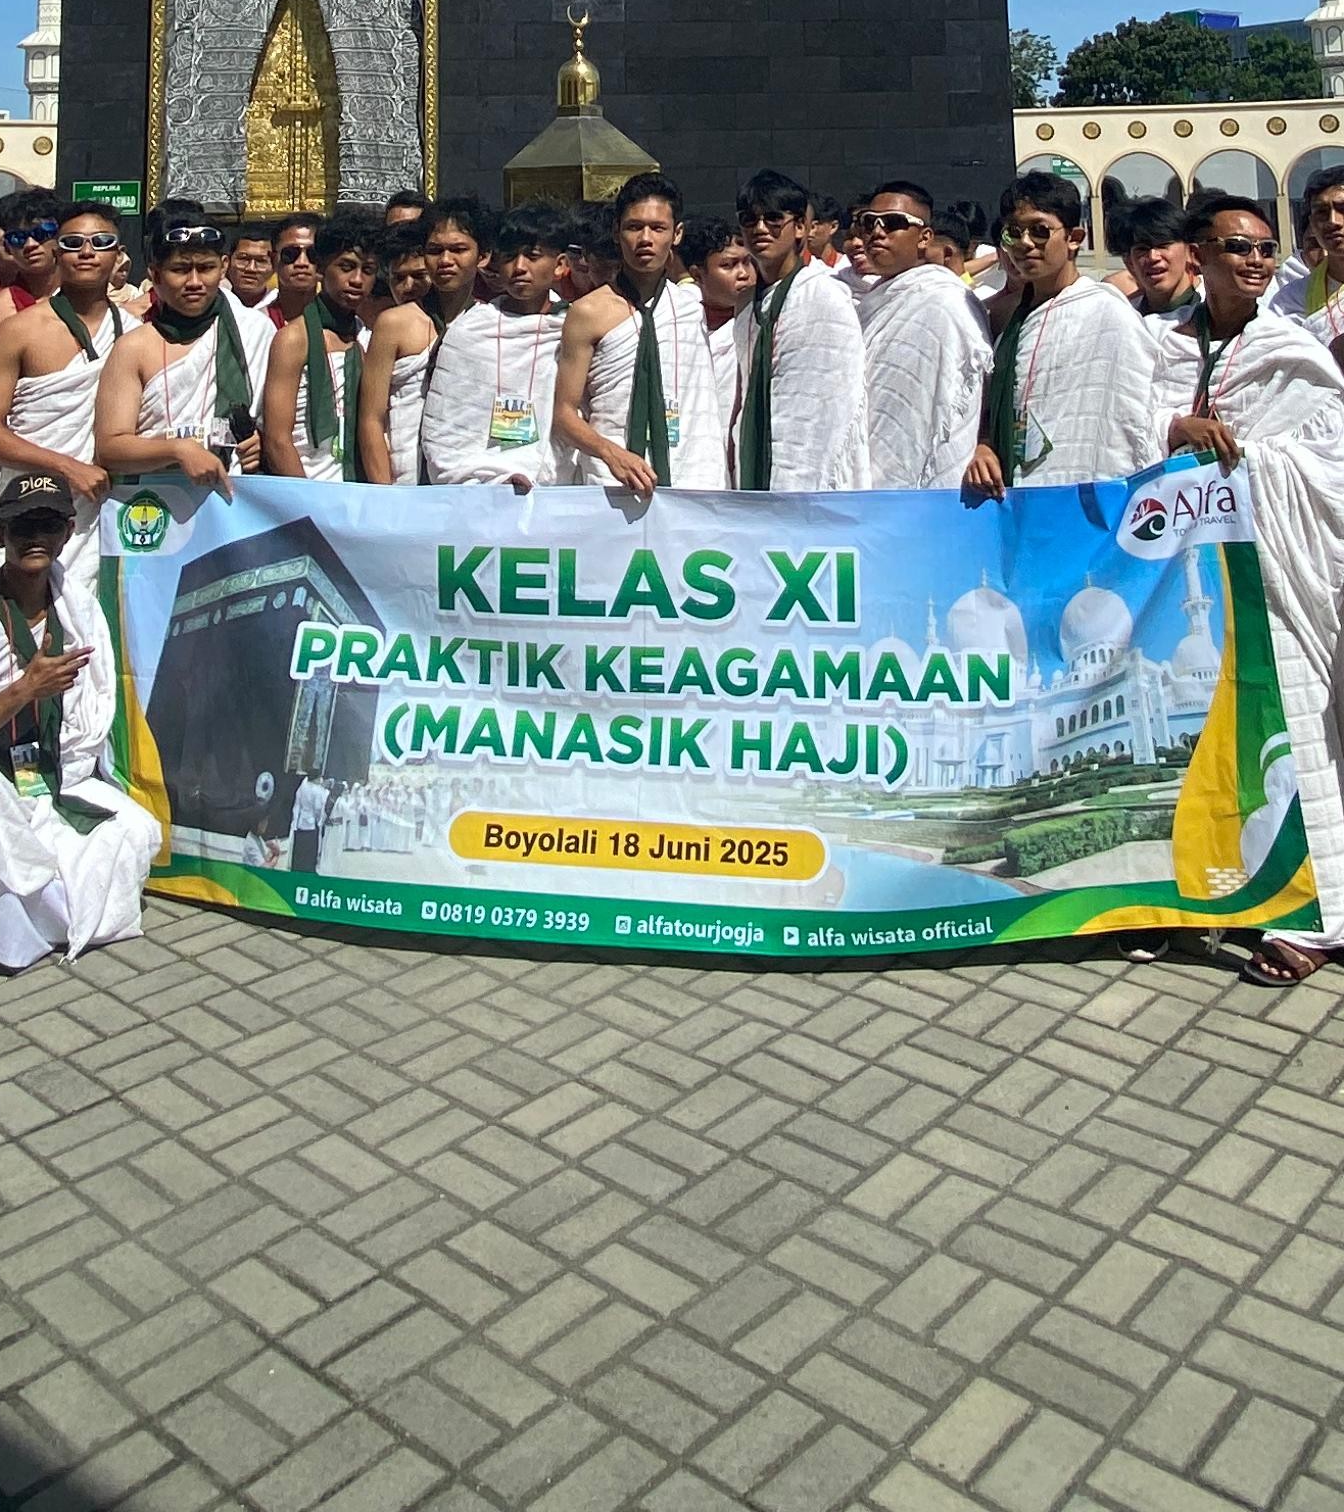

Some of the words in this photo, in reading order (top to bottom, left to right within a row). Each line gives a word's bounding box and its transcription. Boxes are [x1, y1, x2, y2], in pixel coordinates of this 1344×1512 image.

[112, 196, 136, 208] ASWAD
[19, 476, 58, 494] DIOR
[1199, 515, 1236, 527] TRAVEL
[436, 544, 735, 620] KELAS
[766, 550, 856, 623] XI
[295, 627, 568, 692] PRAKTIK
[585, 644, 1011, 702] KEAGAMAAN
[383, 701, 713, 769] (MANASIK
[731, 719, 909, 785] HAJI)
[484, 822, 598, 857] Boyolali
[608, 831, 640, 858] 18
[649, 833, 710, 862] Juni
[720, 838, 789, 867] 2025
[310, 889, 342, 910] alfa
[346, 893, 404, 916] wisata
[439, 902, 487, 925] 0819
[490, 906, 538, 929] 0379
[542, 910, 591, 932] 3939
[635, 915, 765, 945] alfatourjogja
[806, 926, 846, 948] alfa
[850, 925, 917, 946] wisata
[921, 916, 994, 941] official
